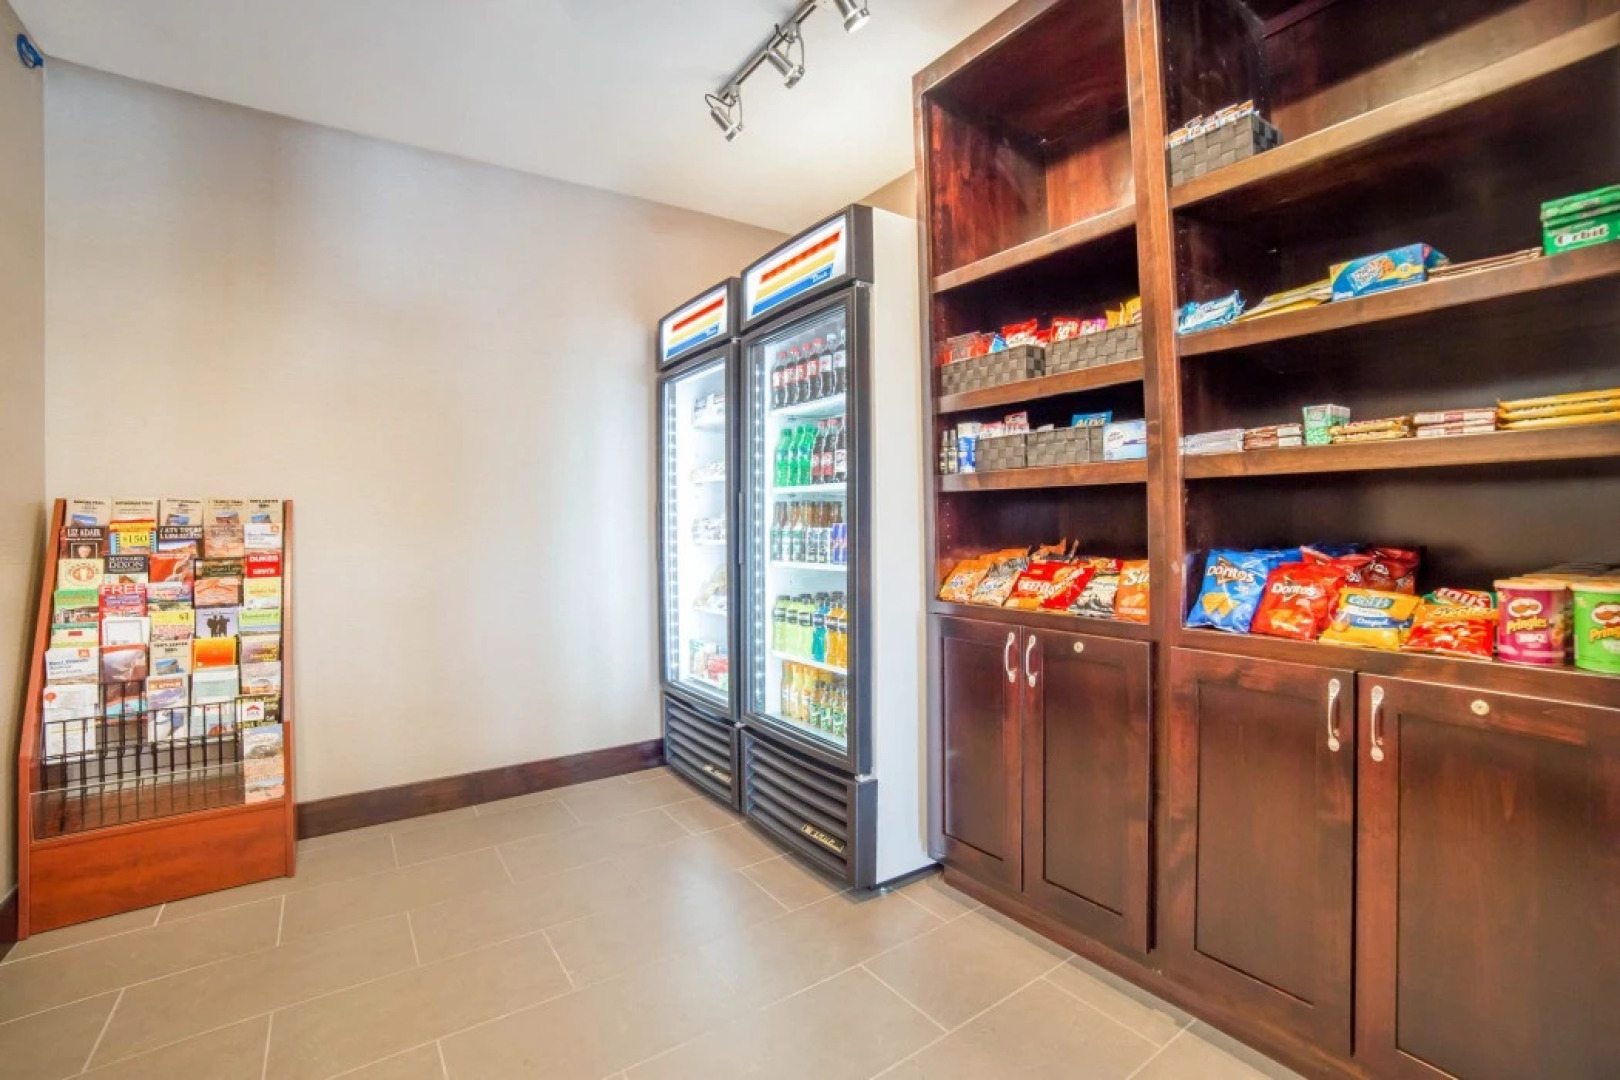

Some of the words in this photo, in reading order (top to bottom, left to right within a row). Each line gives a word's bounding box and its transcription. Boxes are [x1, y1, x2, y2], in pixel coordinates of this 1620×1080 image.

[1207, 565, 1254, 583] Doritos
[101, 584, 146, 595] FREE
[1271, 583, 1318, 598] Doritos
[1505, 616, 1548, 635] Pringles
